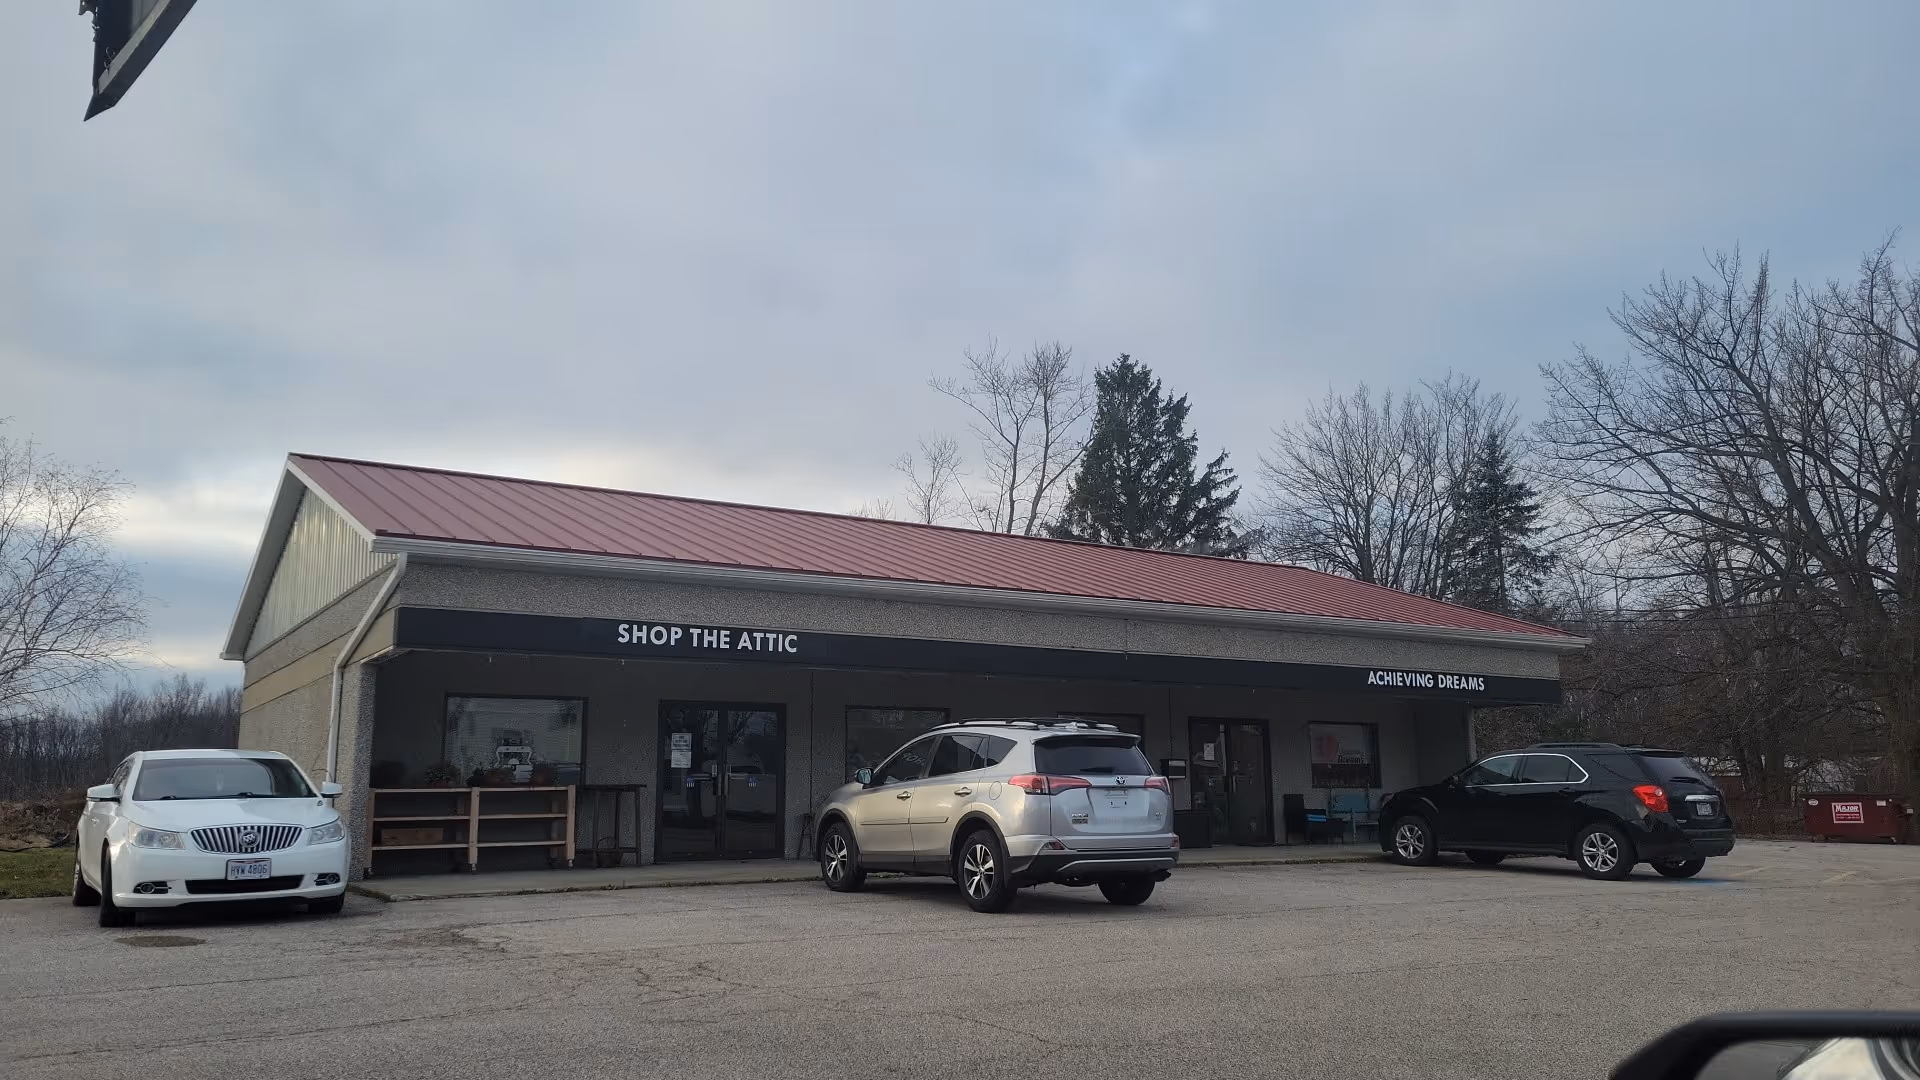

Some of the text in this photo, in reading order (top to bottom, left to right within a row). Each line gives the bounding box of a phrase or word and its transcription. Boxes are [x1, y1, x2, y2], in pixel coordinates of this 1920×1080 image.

[617, 623, 798, 653] SHOP THE ATTIC
[1367, 670, 1485, 691] ACHIEVING DREAMS
